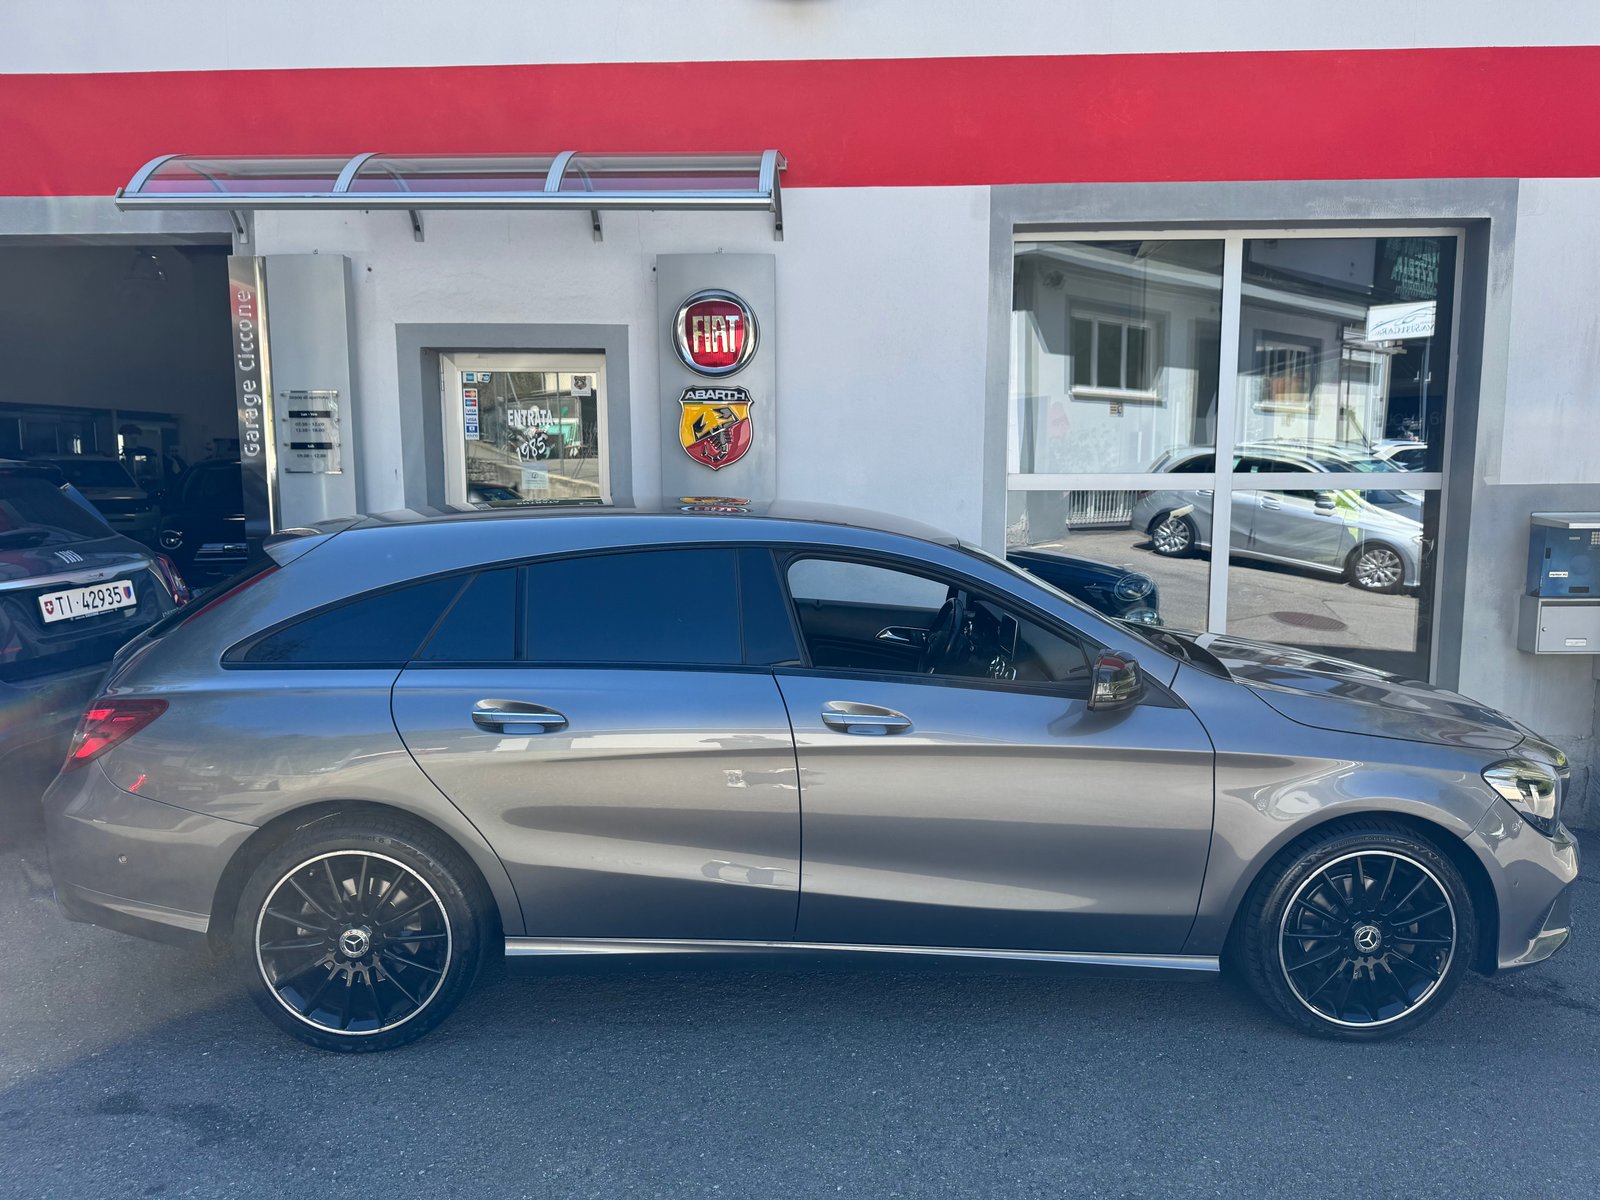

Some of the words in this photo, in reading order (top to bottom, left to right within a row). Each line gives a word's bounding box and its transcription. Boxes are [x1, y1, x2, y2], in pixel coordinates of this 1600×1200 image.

[237, 289, 255, 371] Ciccone
[692, 315, 739, 353] FIAT
[684, 389, 745, 400] ABARTH
[243, 379, 262, 457] Garage
[507, 409, 553, 426] ENTRATA
[516, 434, 548, 463] 1985
